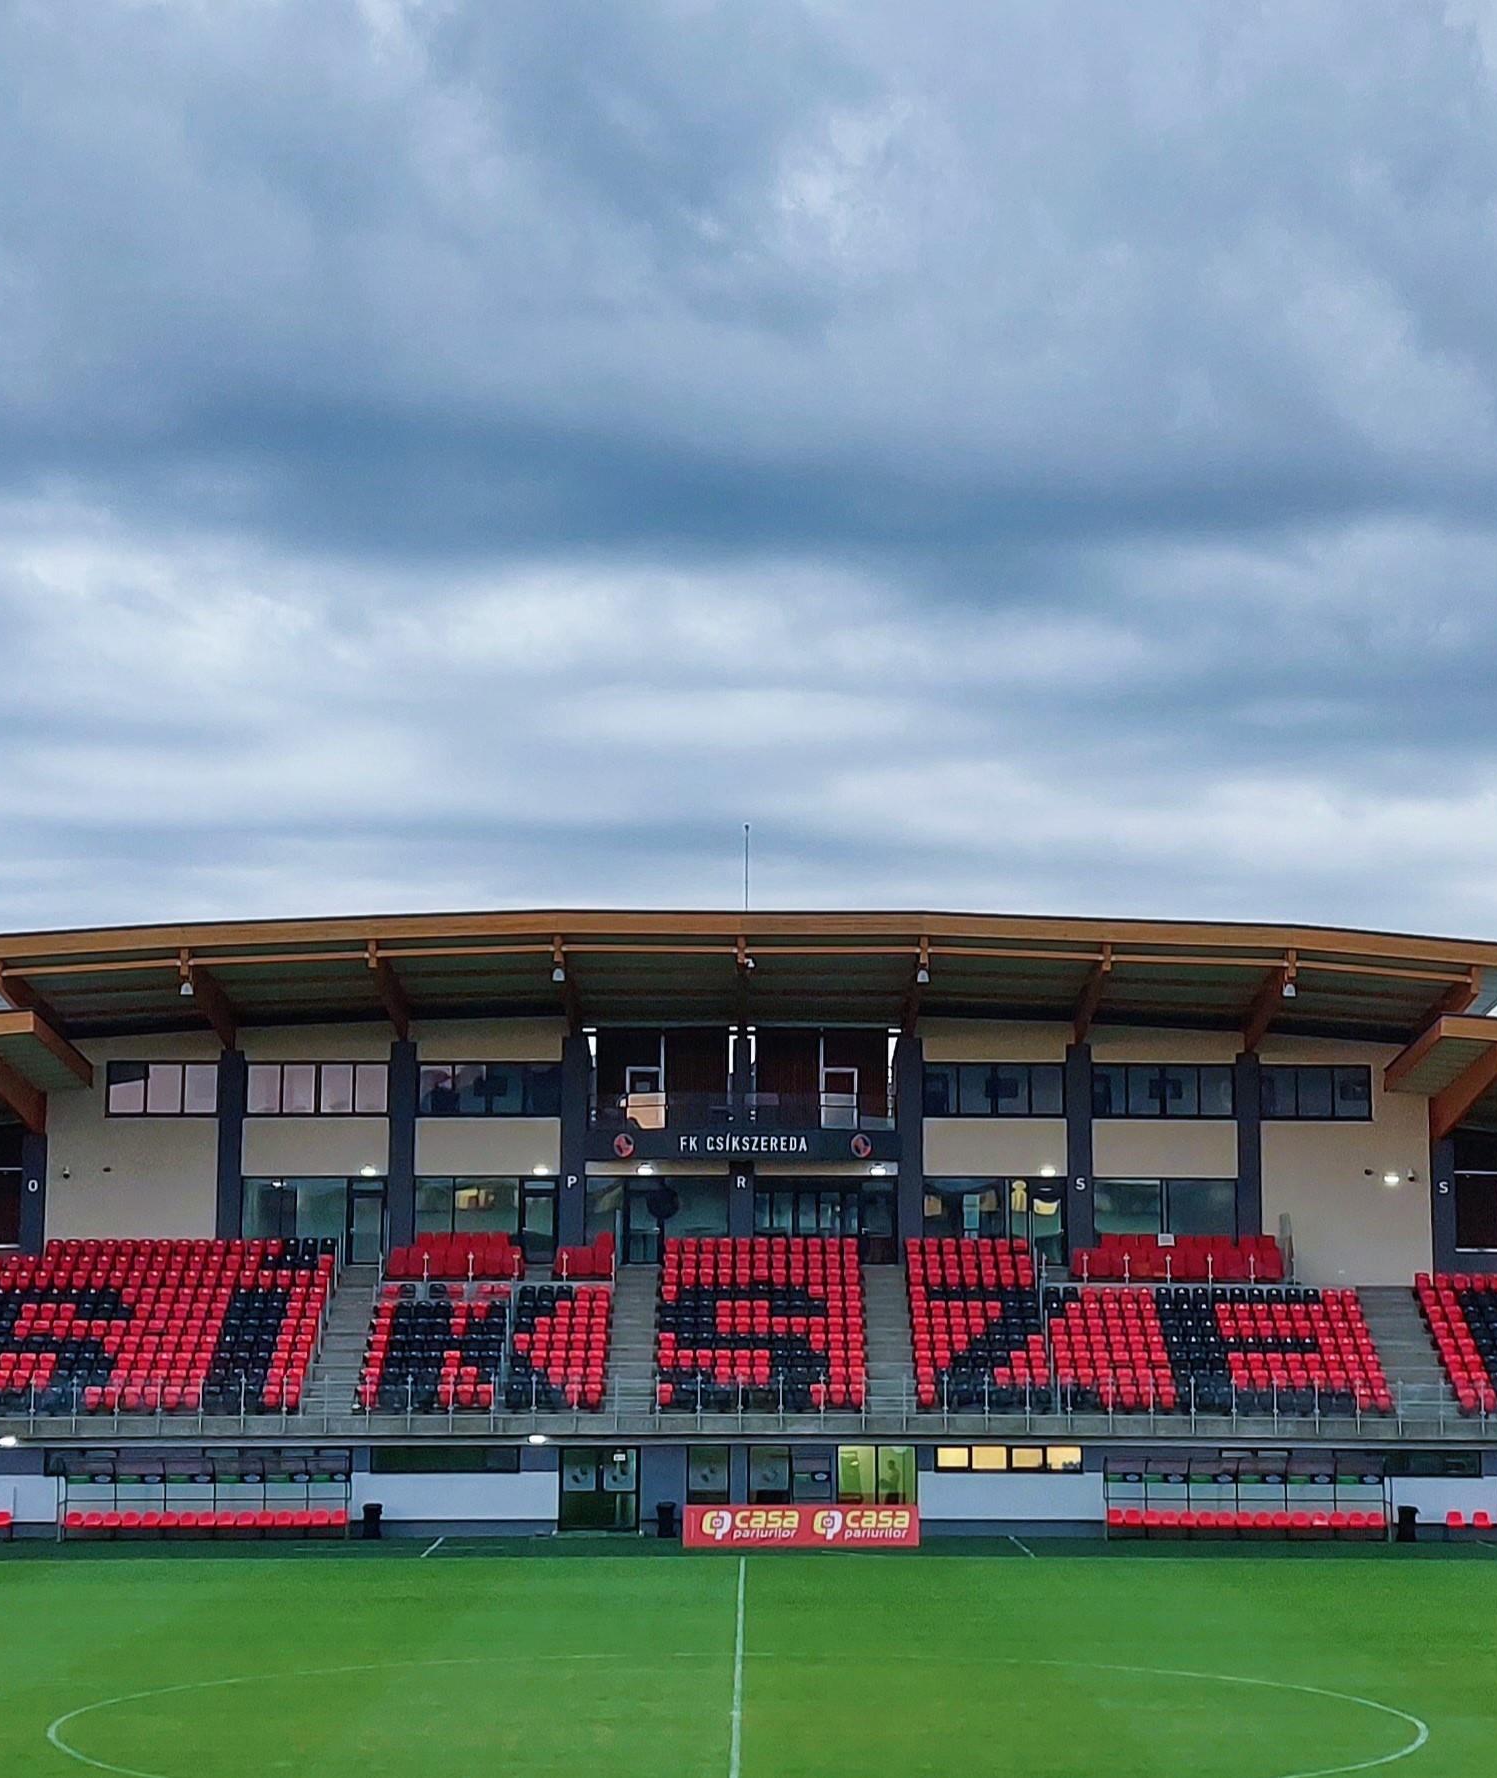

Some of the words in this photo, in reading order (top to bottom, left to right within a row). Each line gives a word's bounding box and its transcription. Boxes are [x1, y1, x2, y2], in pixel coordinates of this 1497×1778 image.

[679, 1135, 698, 1152] FK
[706, 1132, 808, 1152] CSÍKSZEREDA
[567, 1175, 578, 1189] P
[736, 1175, 747, 1189] R
[1075, 1177, 1086, 1191] S
[1438, 1181, 1449, 1194] S
[735, 1510, 800, 1528] casa
[846, 1510, 910, 1528] casa
[733, 1528, 797, 1539] pariurilor
[844, 1528, 908, 1539] pariurilor
